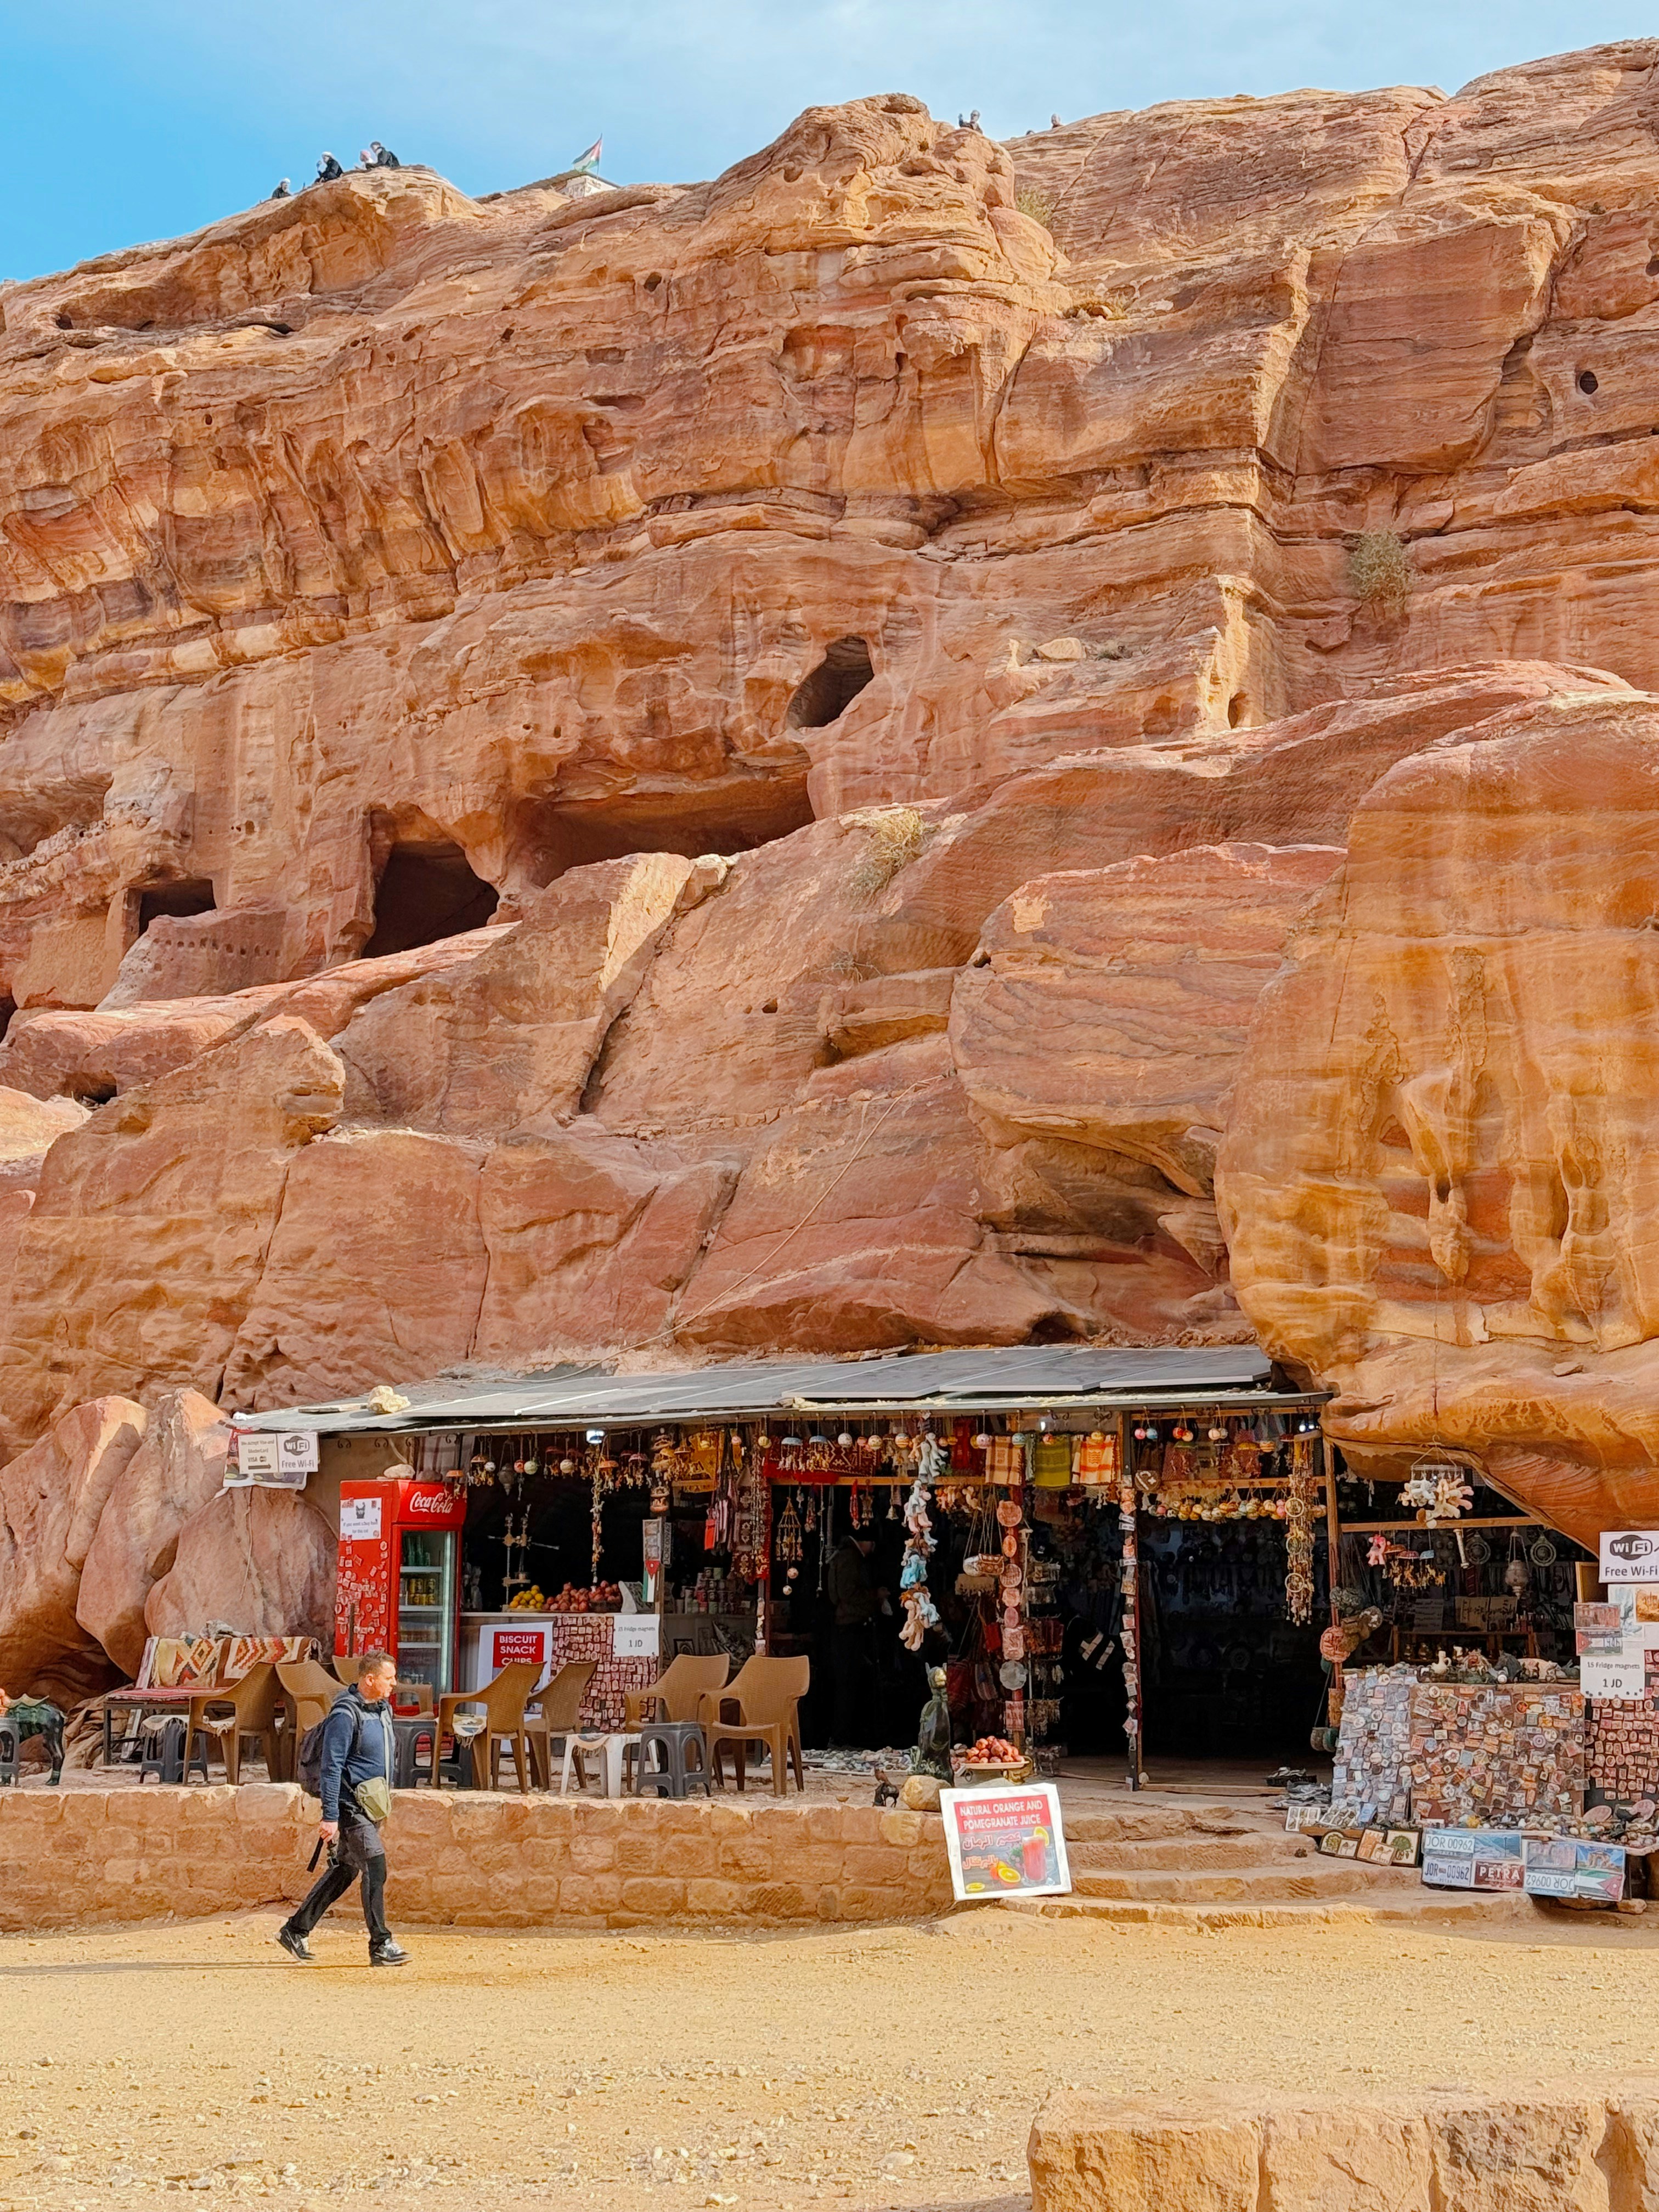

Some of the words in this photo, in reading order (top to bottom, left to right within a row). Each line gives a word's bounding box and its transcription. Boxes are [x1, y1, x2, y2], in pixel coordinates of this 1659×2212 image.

[281, 1460, 296, 1468] Free
[297, 1459, 314, 1468] Wi-Fi
[1605, 1567, 1627, 1576] Free
[1630, 1565, 1657, 1576] Wi-Fi
[499, 1635, 538, 1644] BISCUIT
[628, 1639, 632, 1647] 1
[634, 1639, 642, 1647] JD
[500, 1646, 535, 1654] SNACK
[1602, 1678, 1608, 1687] 1
[1611, 1679, 1622, 1688] JD
[960, 1805, 991, 1817] NATURAL
[992, 1801, 1025, 1813] ORANGE
[1026, 1799, 1043, 1810] AND
[963, 1816, 1019, 1830] POMEGRANATE
[1020, 1814, 1041, 1825] JUICE
[1426, 1835, 1446, 1848] JOR
[1447, 1838, 1473, 1851] 00962
[1425, 1862, 1438, 1876] JOR
[1447, 1865, 1470, 1880] 00962
[1479, 1866, 1520, 1880] PETRA
[1526, 1874, 1551, 1888] 00962
[1553, 1876, 1573, 1890] JOR
